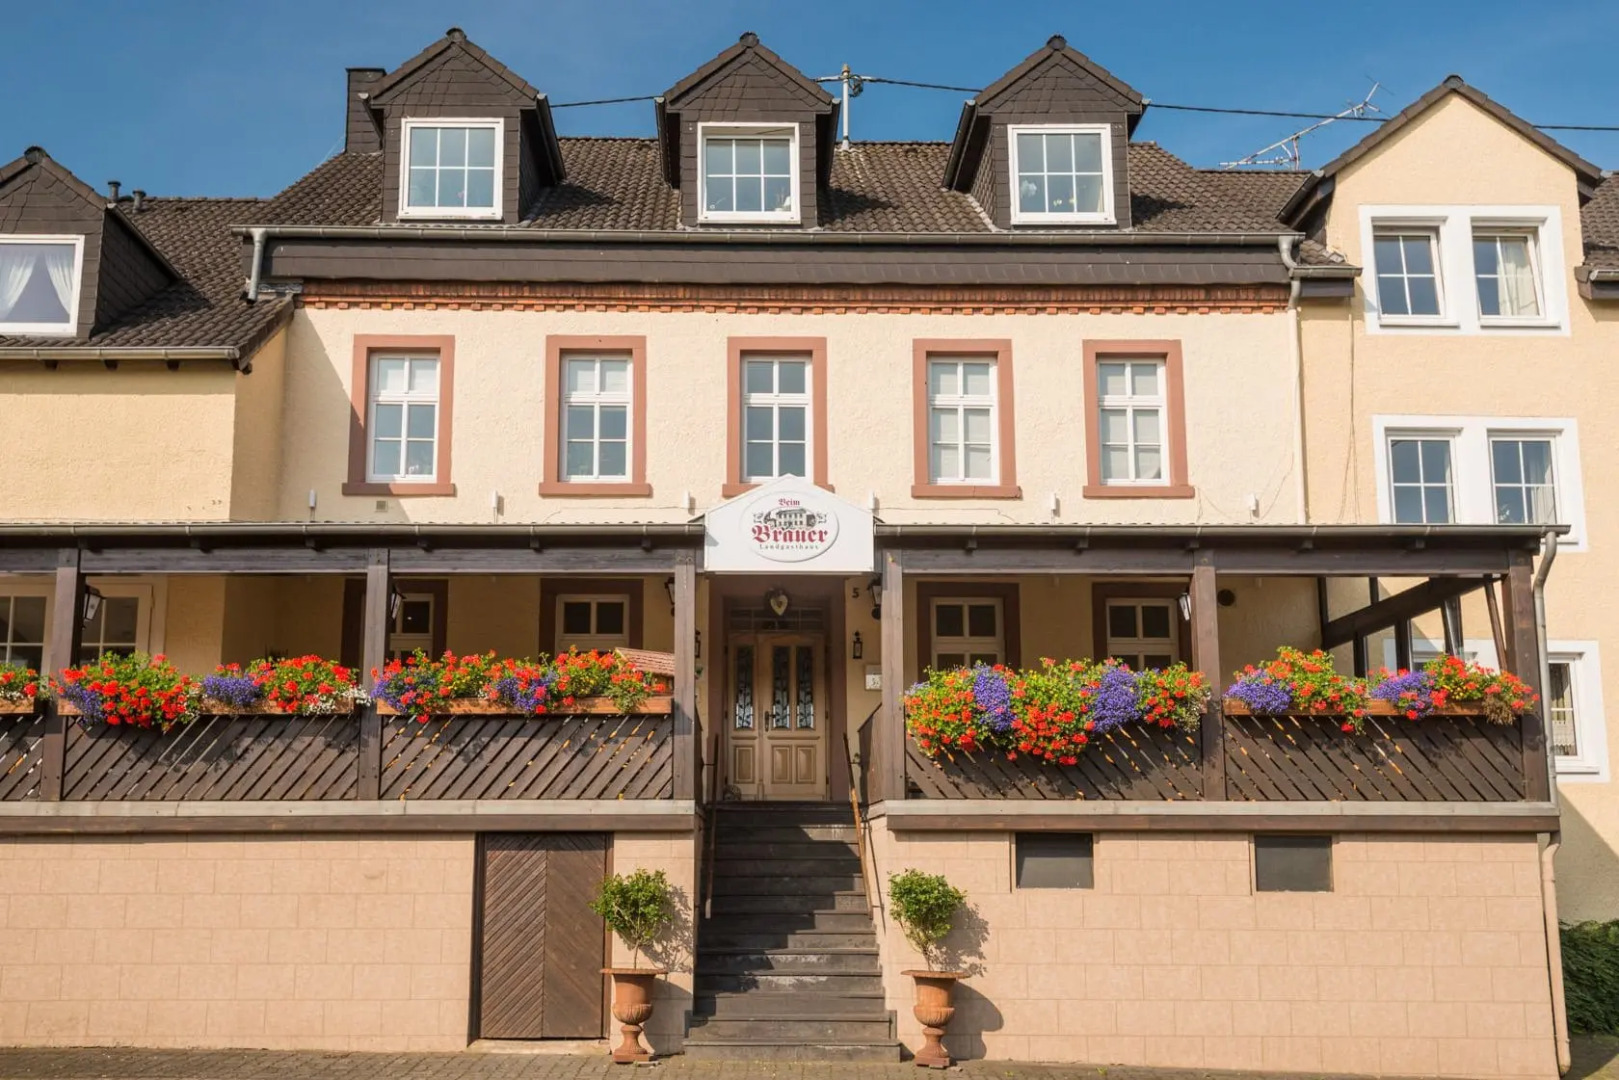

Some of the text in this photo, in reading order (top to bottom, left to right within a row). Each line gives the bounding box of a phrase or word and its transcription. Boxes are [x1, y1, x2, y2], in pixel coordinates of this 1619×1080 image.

[778, 498, 800, 506] Beim
[752, 525, 828, 543] Brauer
[852, 587, 860, 599] 5
